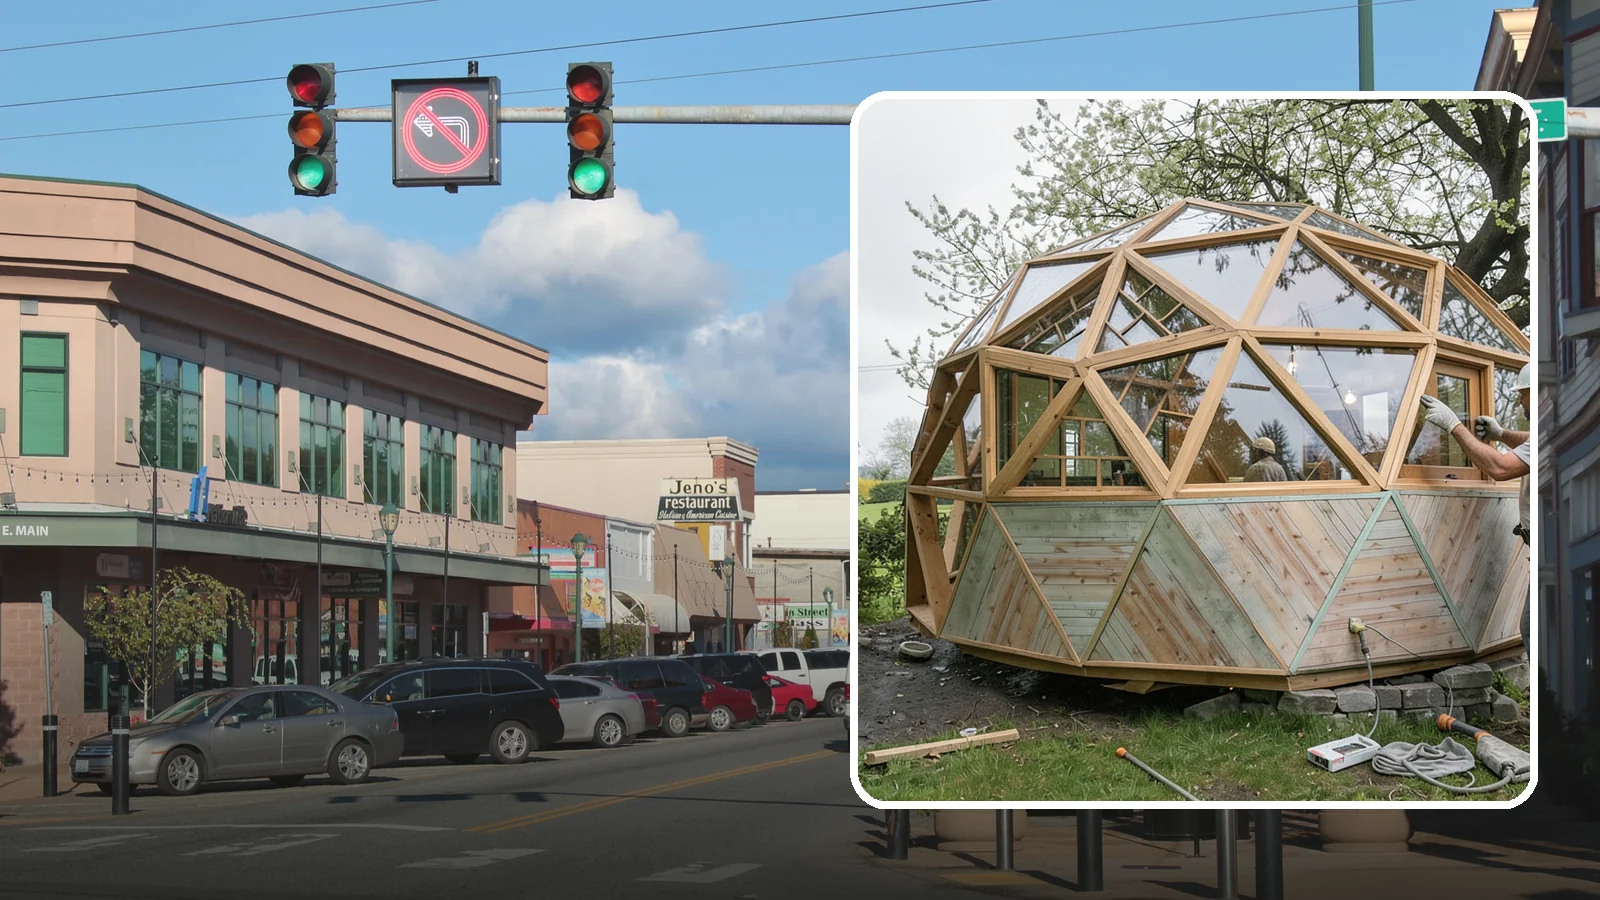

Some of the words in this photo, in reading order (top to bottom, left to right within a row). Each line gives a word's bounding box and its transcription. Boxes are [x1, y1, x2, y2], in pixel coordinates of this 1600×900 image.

[670, 480, 727, 494] Jeno's
[665, 496, 731, 509] restaurant
[659, 510, 681, 520] Italian
[686, 510, 714, 519] American
[715, 510, 737, 519] Cuisine
[2, 525, 13, 536] E.
[15, 525, 49, 536] MAIN
[797, 607, 828, 616] Street
